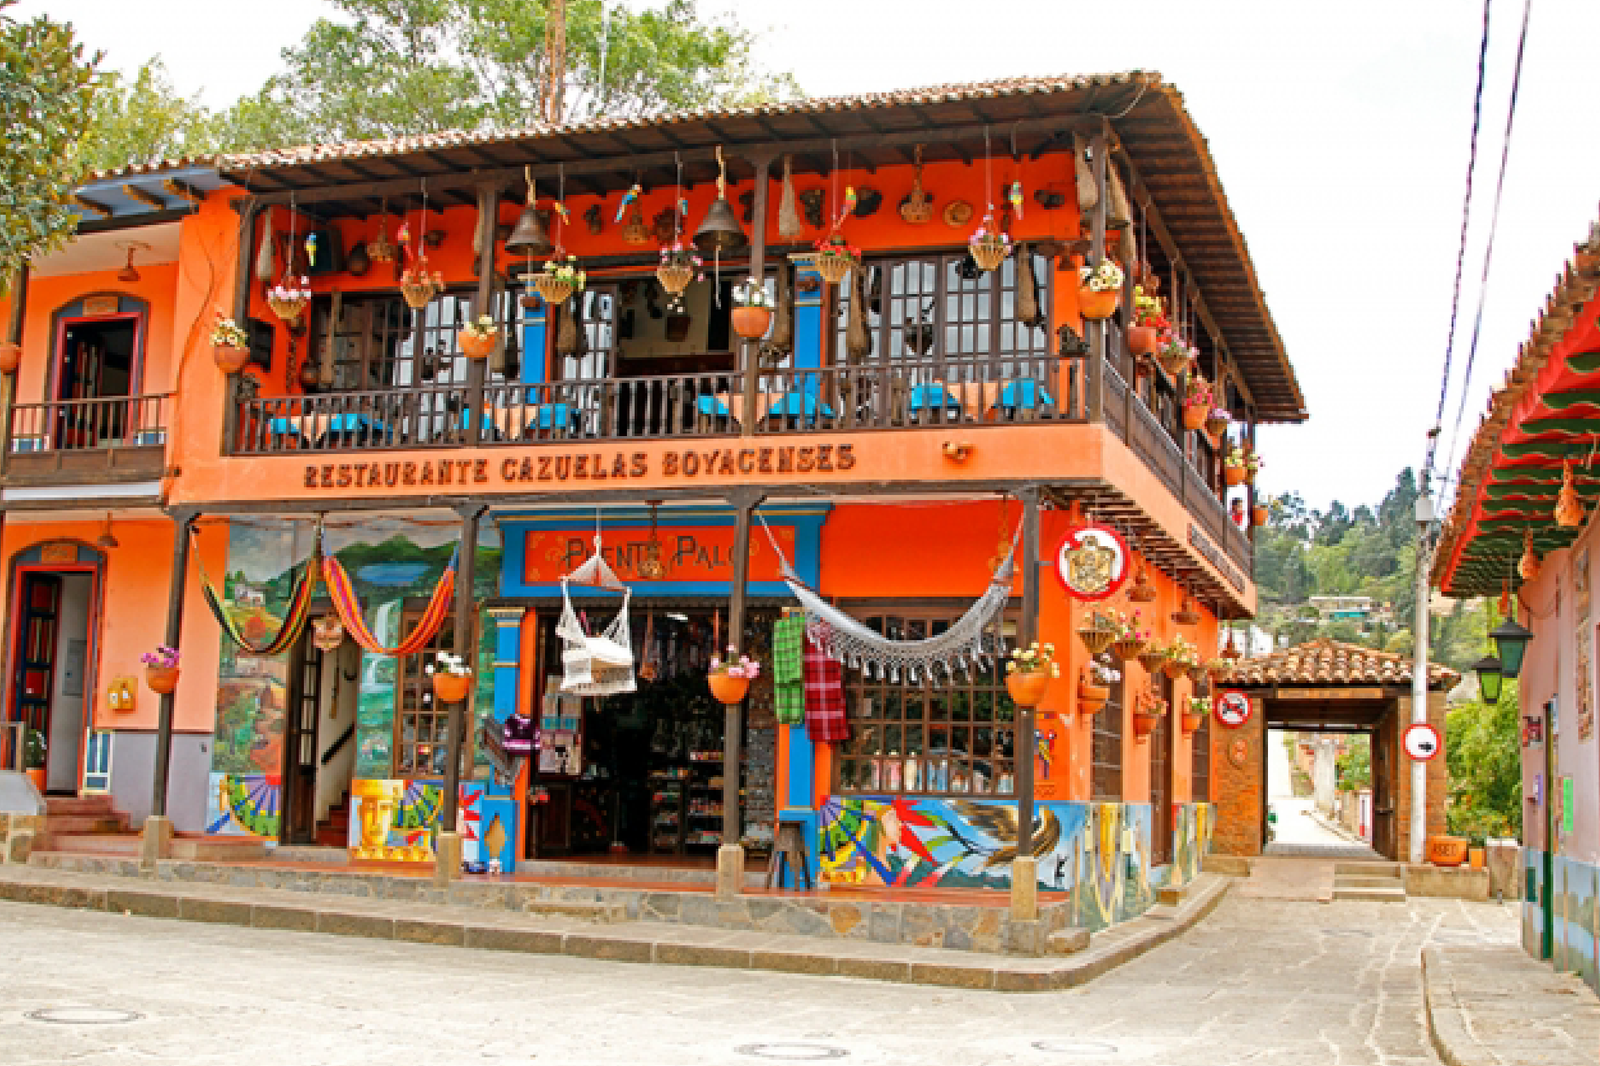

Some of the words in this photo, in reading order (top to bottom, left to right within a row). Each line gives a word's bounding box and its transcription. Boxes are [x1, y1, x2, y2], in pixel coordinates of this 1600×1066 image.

[304, 458, 490, 489] RESTAURANTE
[500, 451, 649, 482] CAZUELAS
[661, 443, 856, 478] BOYACENSES
